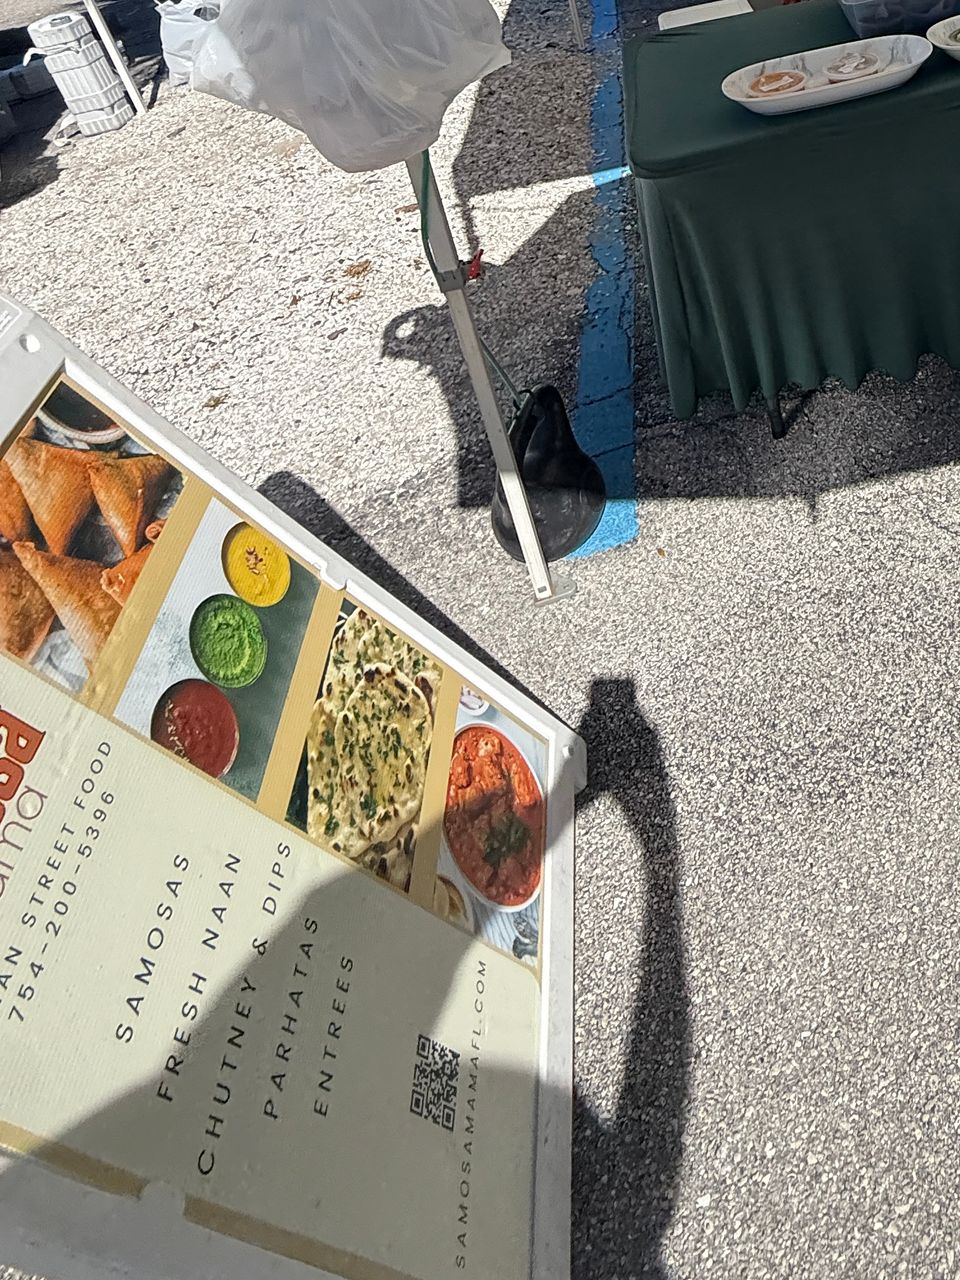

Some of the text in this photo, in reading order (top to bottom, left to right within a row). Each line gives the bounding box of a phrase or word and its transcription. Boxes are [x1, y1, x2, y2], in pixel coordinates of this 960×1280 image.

[7, 790, 115, 1023] 754-200-5396
[21, 822, 75, 929] STREET
[74, 741, 112, 811] FOOD
[115, 853, 190, 1043] SAMOSAS
[156, 853, 241, 1102] FRESH NAAN
[197, 841, 291, 1176] CHUTNEY & DIPS
[263, 917, 319, 1120] PARHATAS
[313, 956, 354, 1118] ENTREES
[455, 960, 487, 1270] SAMOSAMAMAFL.COM
